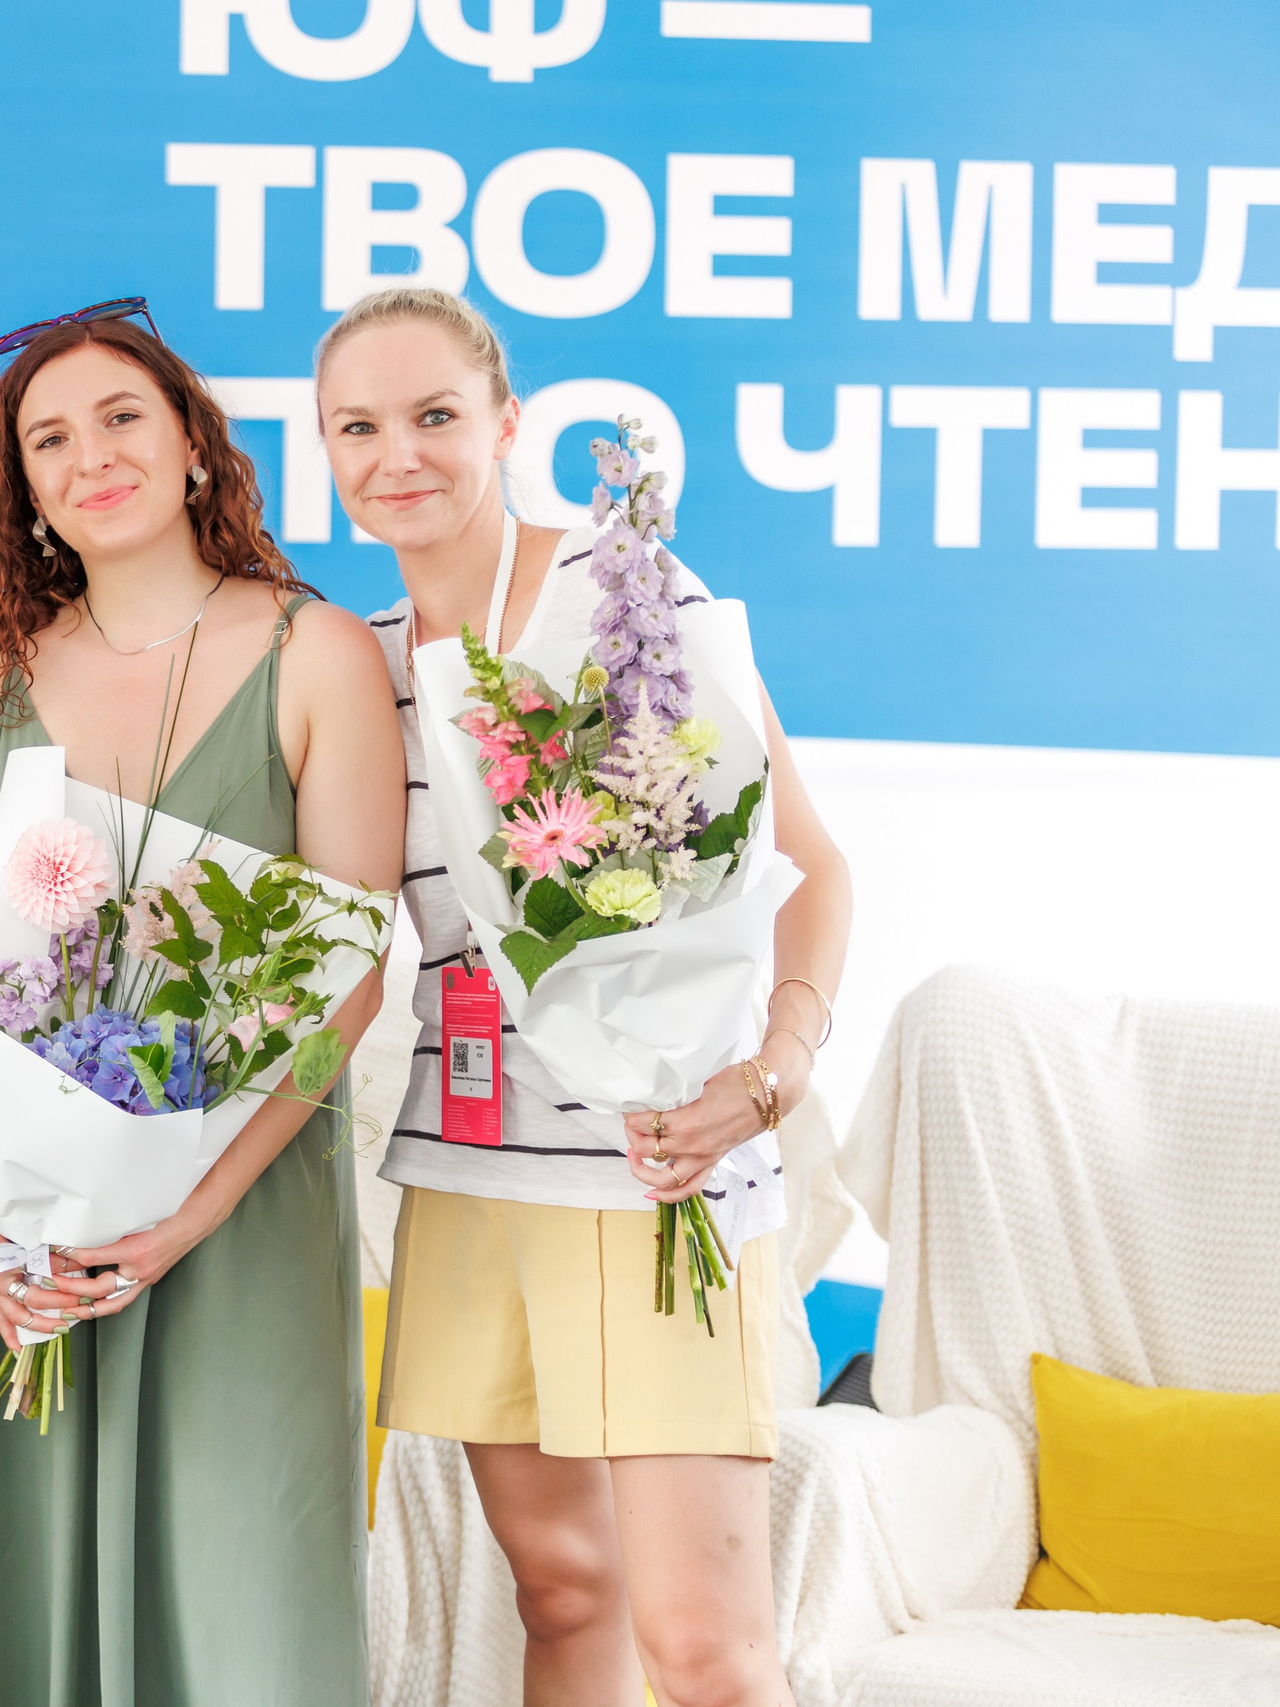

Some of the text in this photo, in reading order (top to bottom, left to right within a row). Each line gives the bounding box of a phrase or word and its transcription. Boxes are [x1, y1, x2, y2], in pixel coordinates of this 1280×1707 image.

[164, 142, 1280, 362] ТВОЕ МЕД
[210, 377, 1280, 551] ПО ЧТЕН
